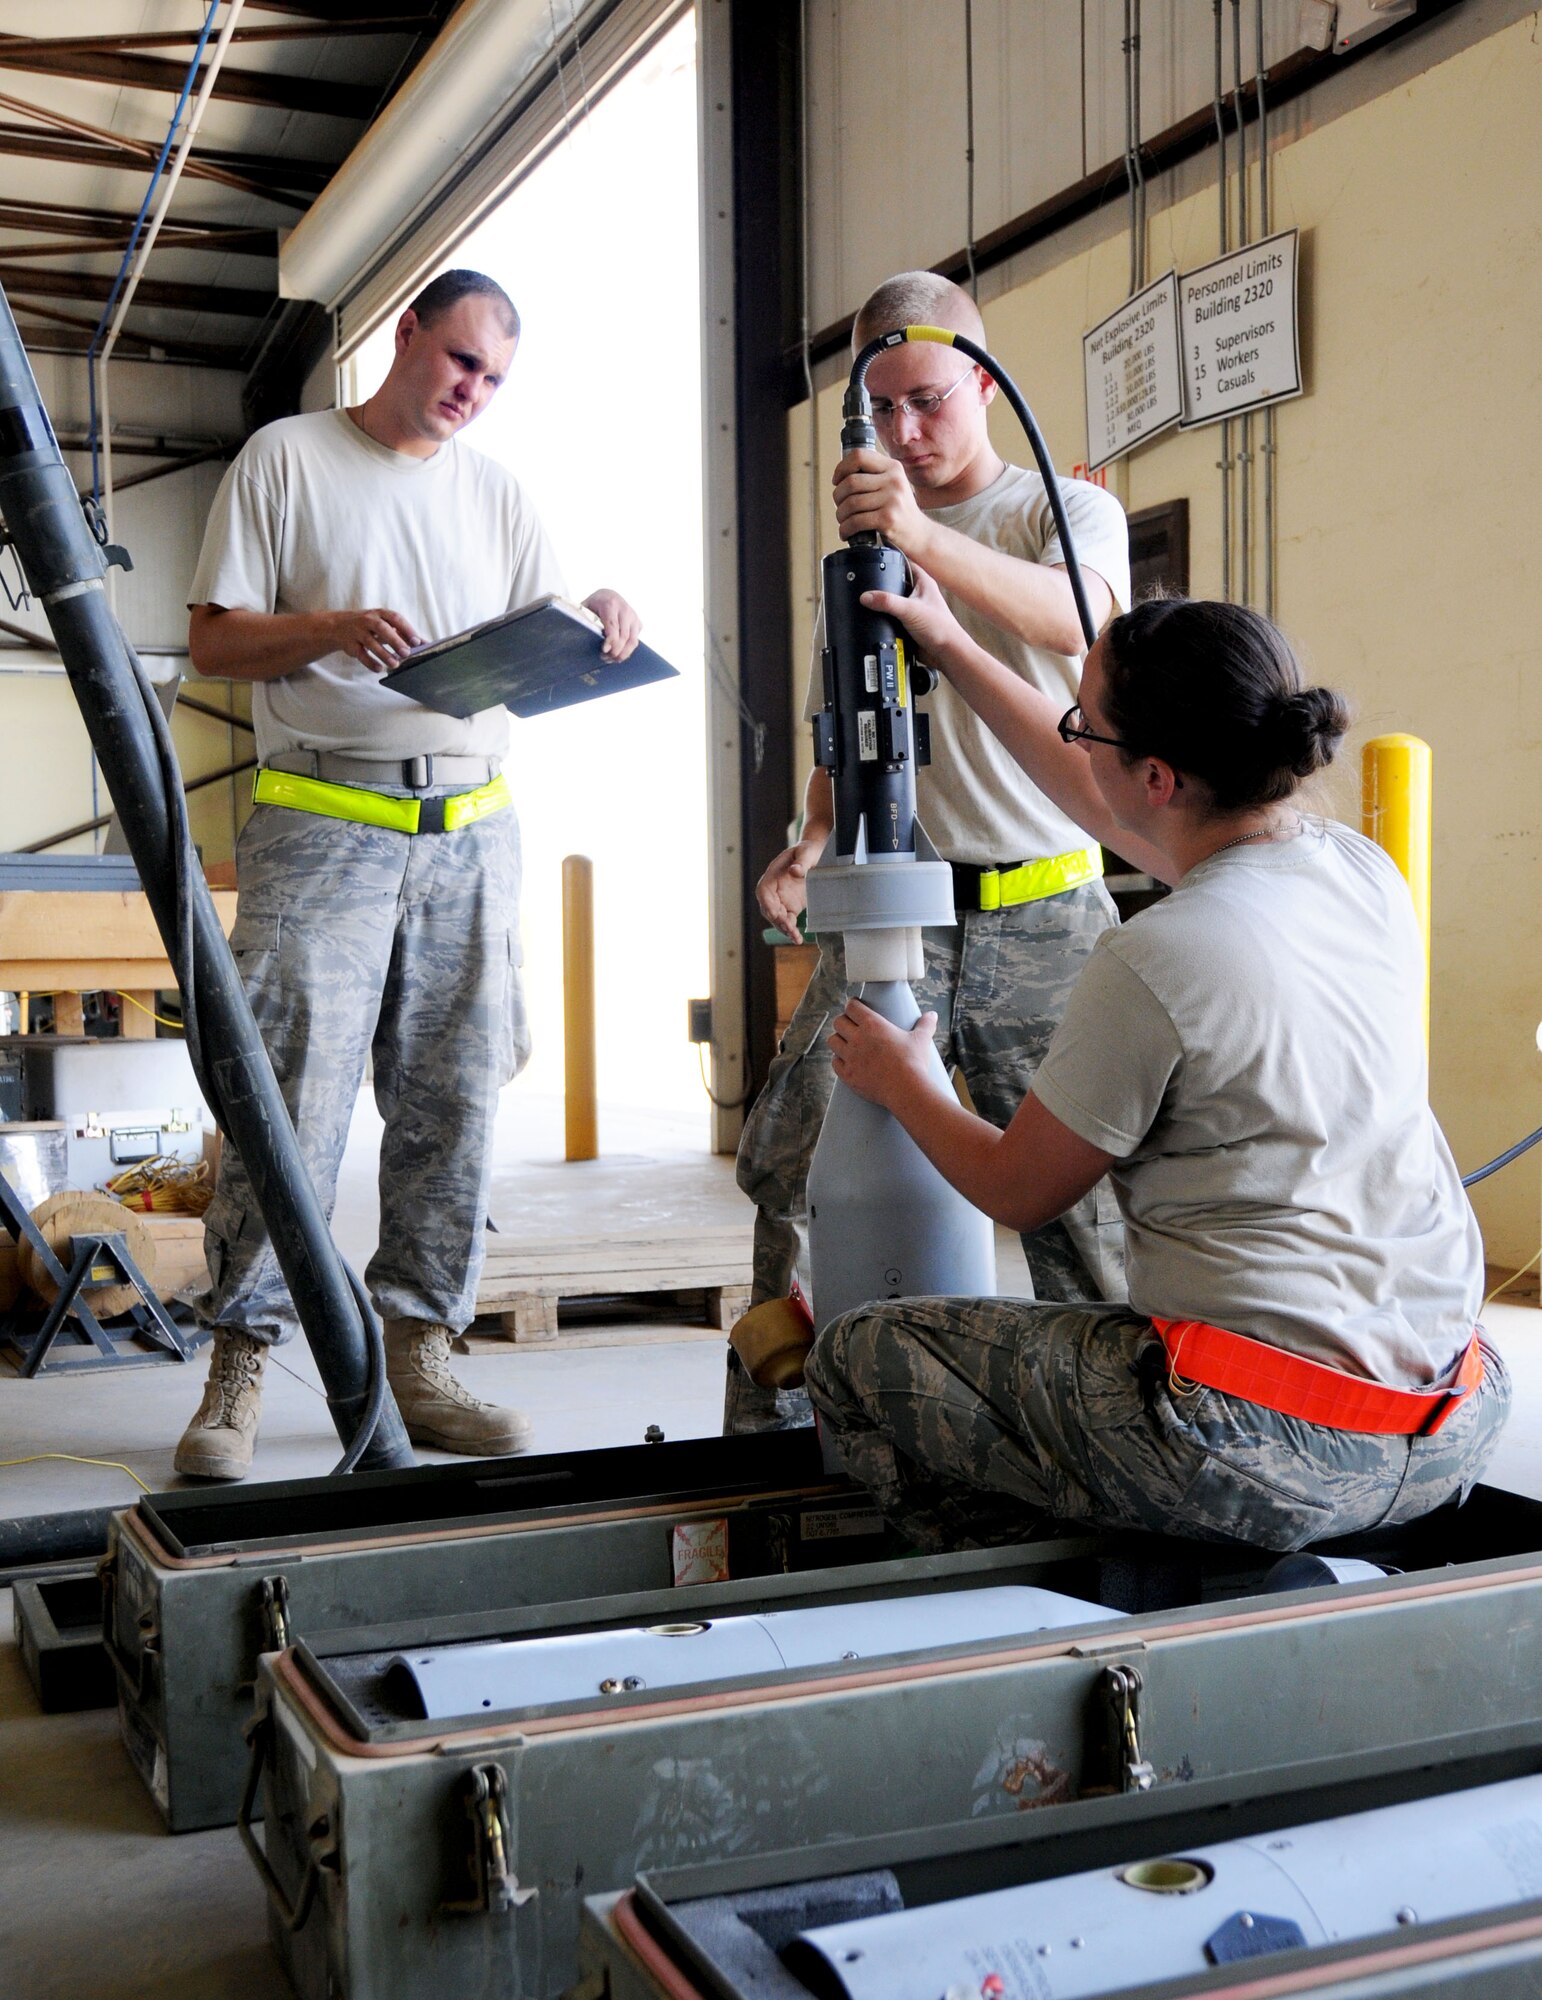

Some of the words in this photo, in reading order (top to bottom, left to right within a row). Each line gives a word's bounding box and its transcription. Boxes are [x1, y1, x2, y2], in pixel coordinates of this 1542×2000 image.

[1188, 270, 1243, 303] Personnel
[1247, 253, 1283, 278] Limits
[1195, 294, 1241, 324] Building
[1244, 279, 1274, 305] 2320
[1090, 338, 1104, 356] Net
[1104, 309, 1142, 346] Explosive
[1142, 290, 1168, 315] Limits
[1102, 331, 1134, 365] Building
[1134, 317, 1156, 343] 2320
[1194, 346, 1200, 360] 3
[1215, 320, 1275, 353] Supervisors
[1195, 364, 1207, 381] 15
[1217, 347, 1260, 373] Workers
[1196, 386, 1202, 401] 3
[1217, 369, 1256, 394] Casuals
[885, 664, 894, 680] PW
[890, 802, 898, 820] BFD
[677, 1544, 725, 1562] FRAGILE
